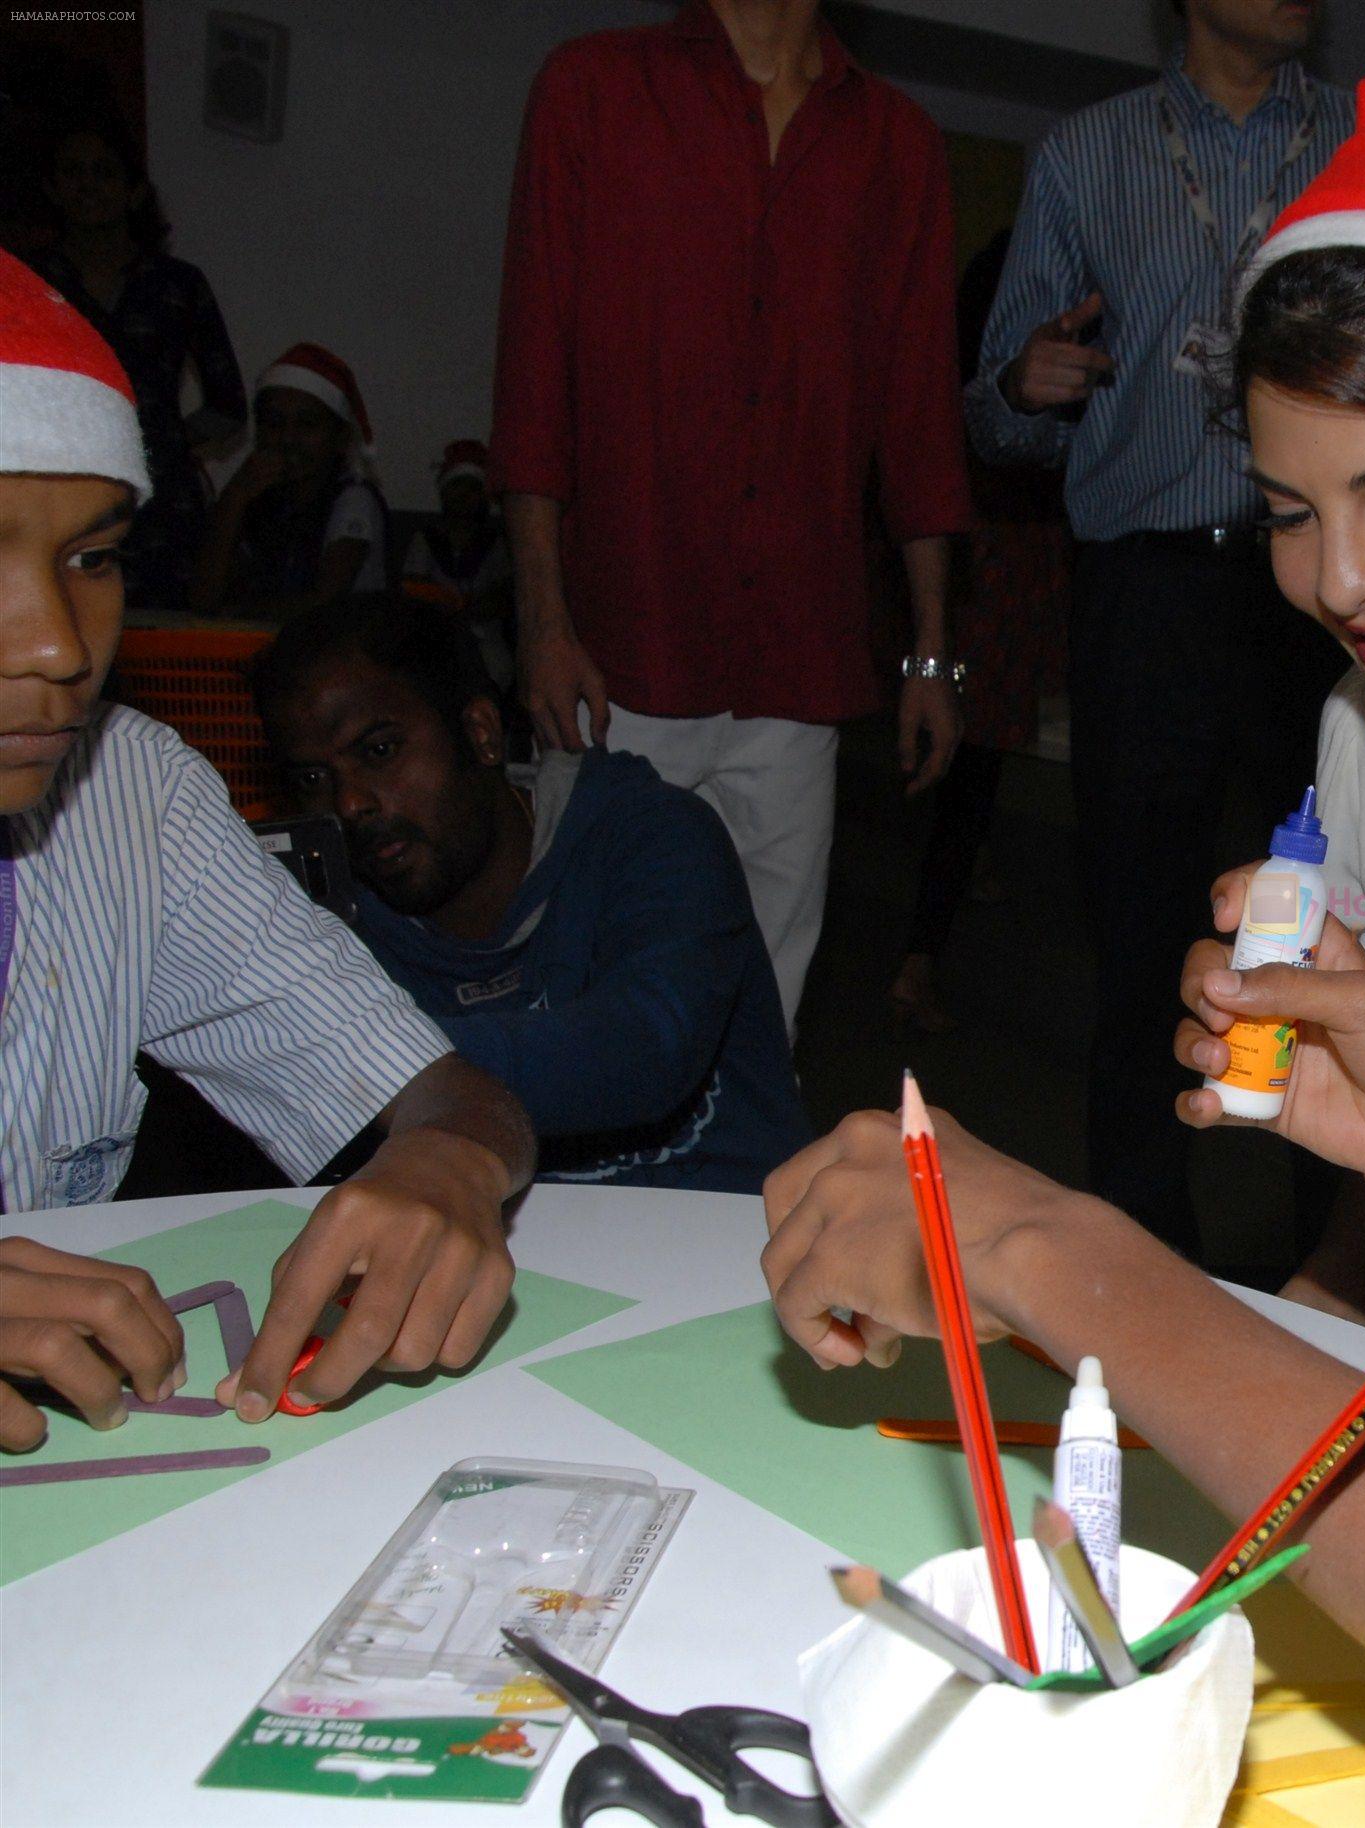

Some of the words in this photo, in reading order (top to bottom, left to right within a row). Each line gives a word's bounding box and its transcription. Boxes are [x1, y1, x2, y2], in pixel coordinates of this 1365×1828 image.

[1266, 1500, 1294, 1529] 621
[612, 1522, 663, 1598] SCISSORS
[258, 1714, 324, 1731] Quality
[322, 1718, 365, 1735] Euro
[252, 1726, 422, 1753] GORILLA
